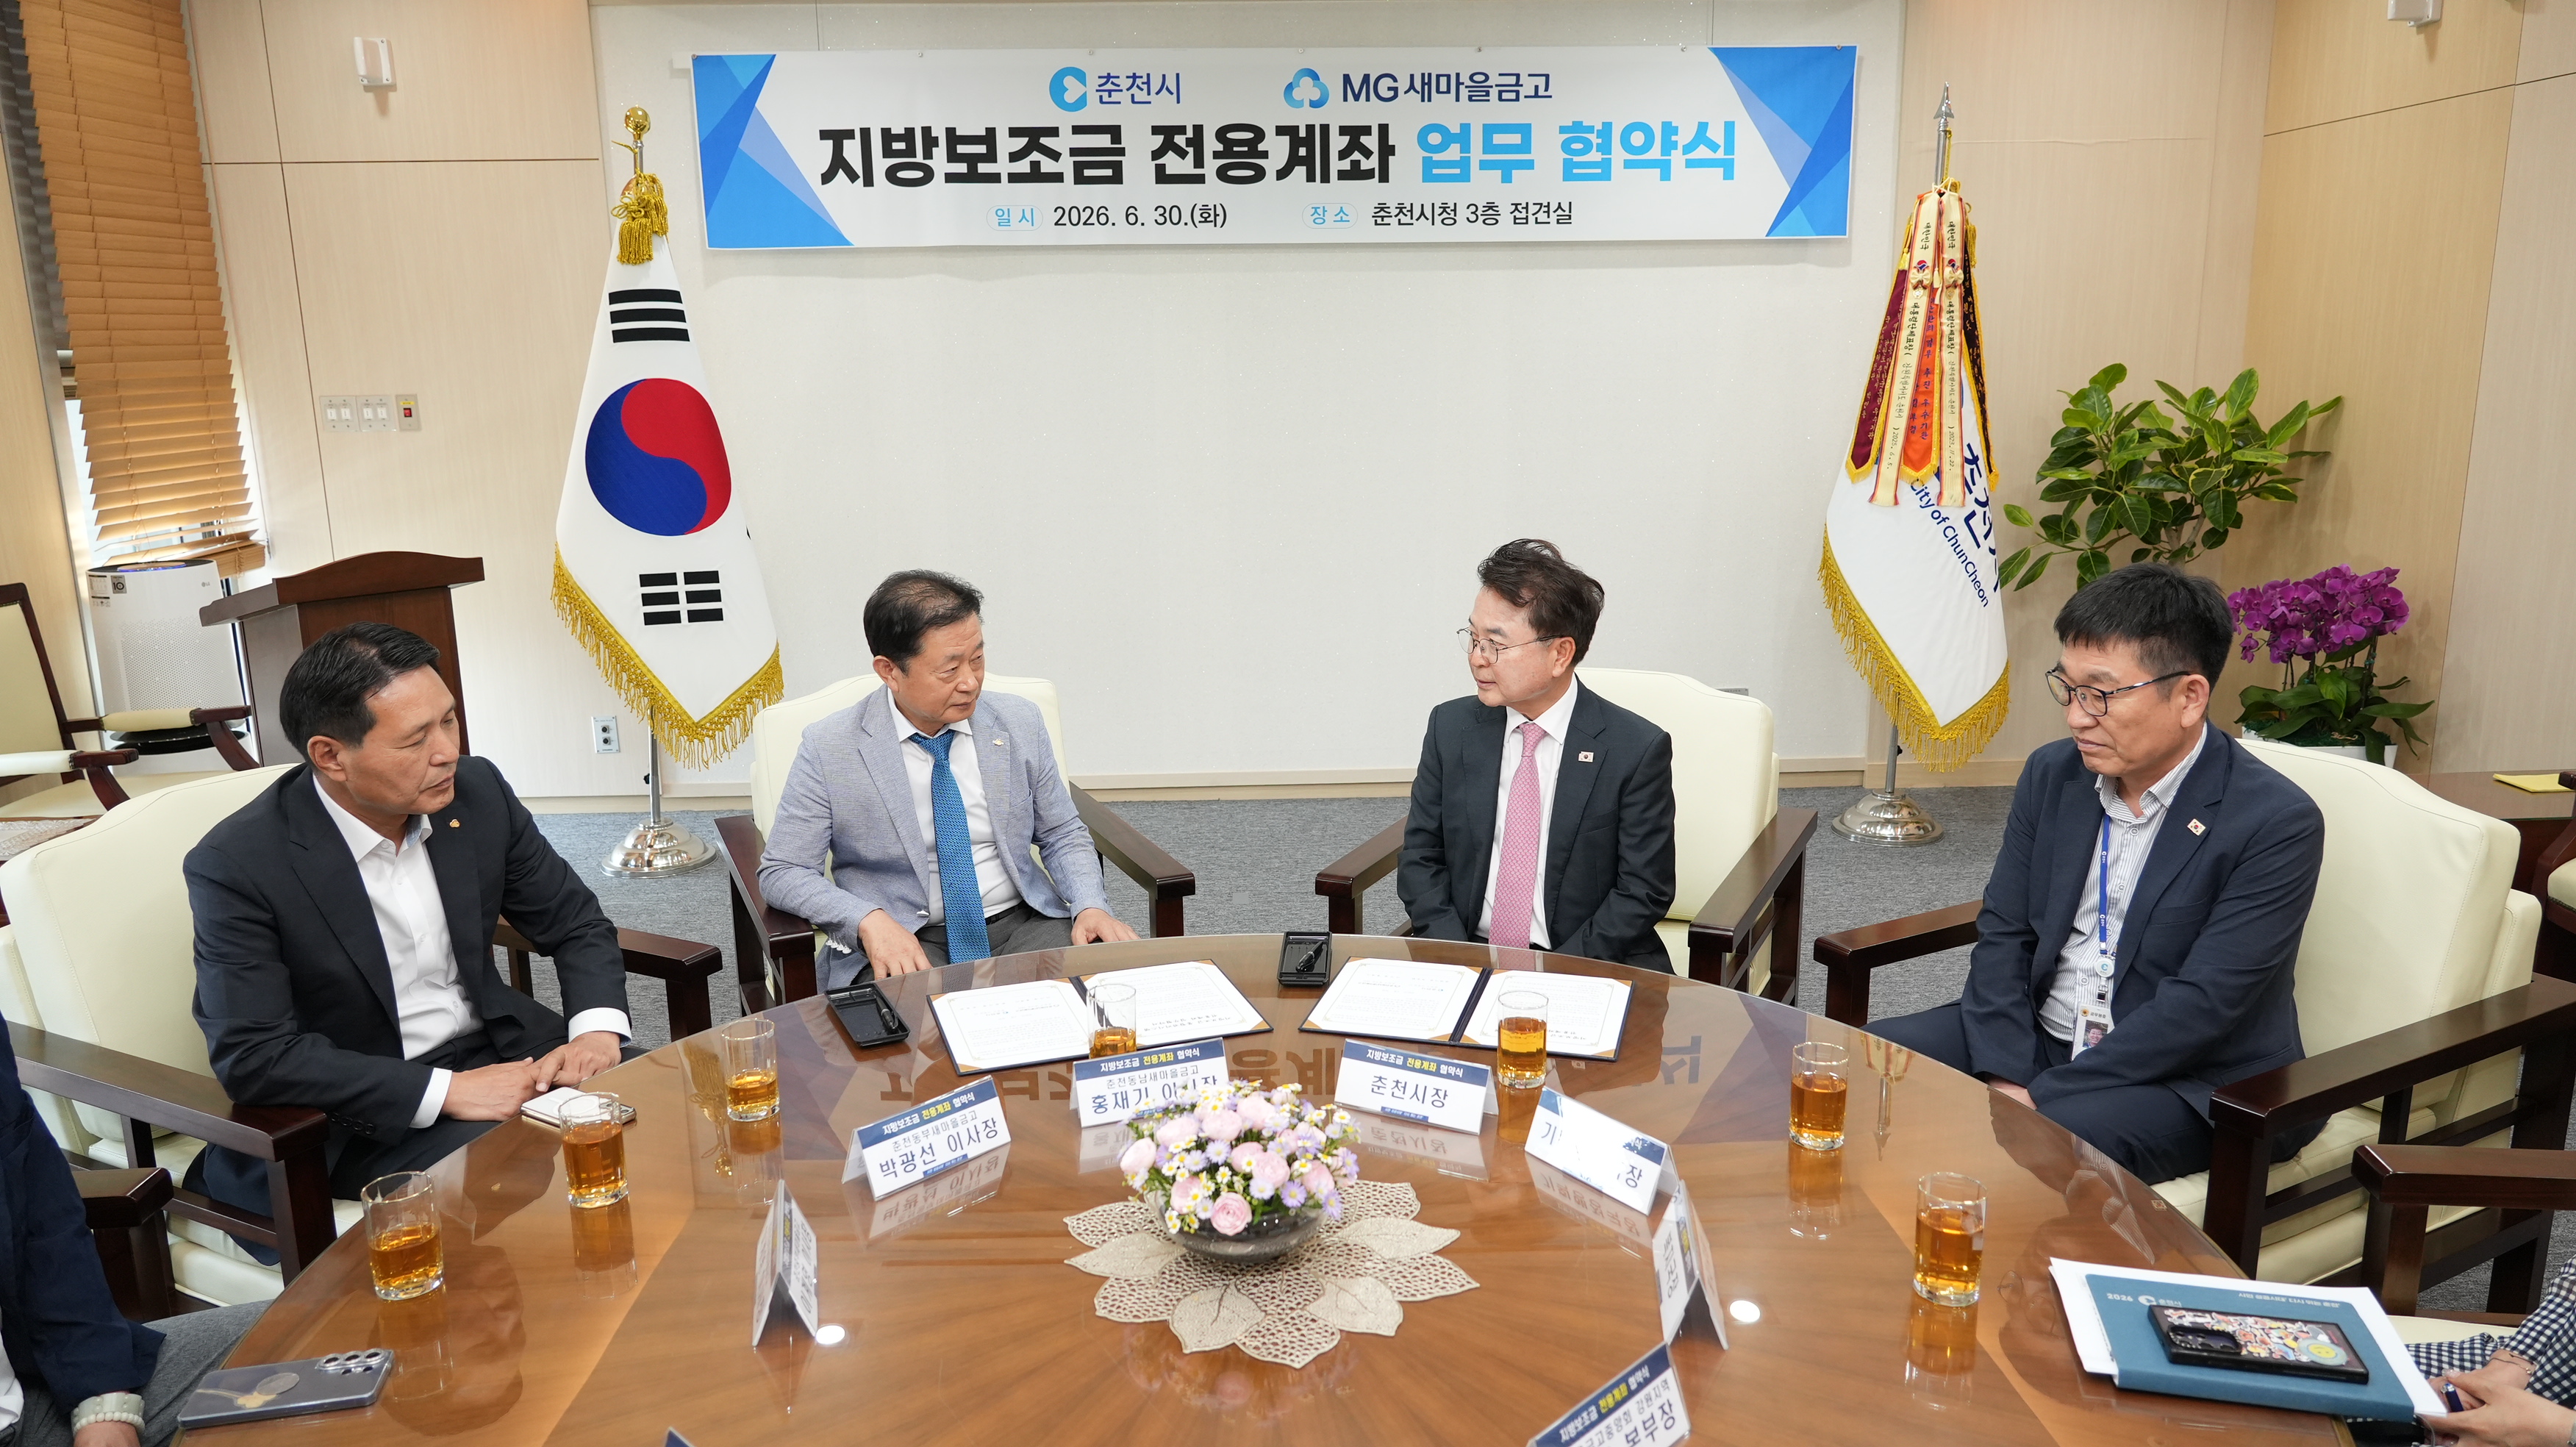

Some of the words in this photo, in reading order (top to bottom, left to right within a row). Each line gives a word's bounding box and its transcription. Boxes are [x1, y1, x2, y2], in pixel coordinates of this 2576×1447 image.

[1095, 72, 1182, 105] 춘천시
[1342, 71, 1553, 104] MG새마을금고
[818, 124, 1126, 188] 지방보조금
[1151, 123, 1395, 185] 전용계좌
[1417, 122, 1536, 184] 업무
[1559, 120, 1736, 182] 협약식
[1053, 206, 1116, 228] 2026.
[1124, 207, 1145, 227] 6.
[1153, 204, 1227, 228] 30.(화)
[1372, 201, 1459, 227] 춘천시청
[1466, 202, 1501, 225] 3층
[1509, 201, 1574, 225] 접견실
[1920, 222, 1931, 251] 대한민국
[1947, 221, 1956, 249] 대한민국
[1925, 338, 1933, 359] 업무
[1923, 368, 1932, 390] 추진
[1868, 407, 1879, 440] 우수기관
[1920, 399, 1930, 440] 우수기관
[1910, 479, 1936, 509] City
[1931, 509, 1950, 526] of
[1943, 525, 1989, 608] ChunCheon
[1101, 1059, 1140, 1073] 지방보조금
[1142, 1052, 1174, 1066] 전용계좌
[1176, 1047, 1201, 1060] 협약식
[1366, 1048, 1403, 1065] 지방보조금
[1406, 1057, 1437, 1073] 전용계좌
[1439, 1064, 1464, 1078] 협약식
[1106, 1065, 1199, 1090] 춘천동남새마을금고
[1371, 1075, 1449, 1109] 춘천시장
[881, 1113, 920, 1136] 지방보조금
[921, 1101, 951, 1121] 전용계좌
[953, 1092, 976, 1109] 협약식
[1091, 1087, 1149, 1115] 홍재기
[892, 1110, 978, 1152] 춘천동부새마을금고
[879, 1142, 937, 1179] 박광선
[947, 1117, 999, 1152] 이사장
[2107, 1293, 2133, 1301] 2026
[1559, 1405, 1599, 1443] 지방보조금
[1598, 1382, 1629, 1414] 전용계좌
[1628, 1365, 1651, 1391] 협약식
[1636, 1379, 1670, 1415] 강원지역
